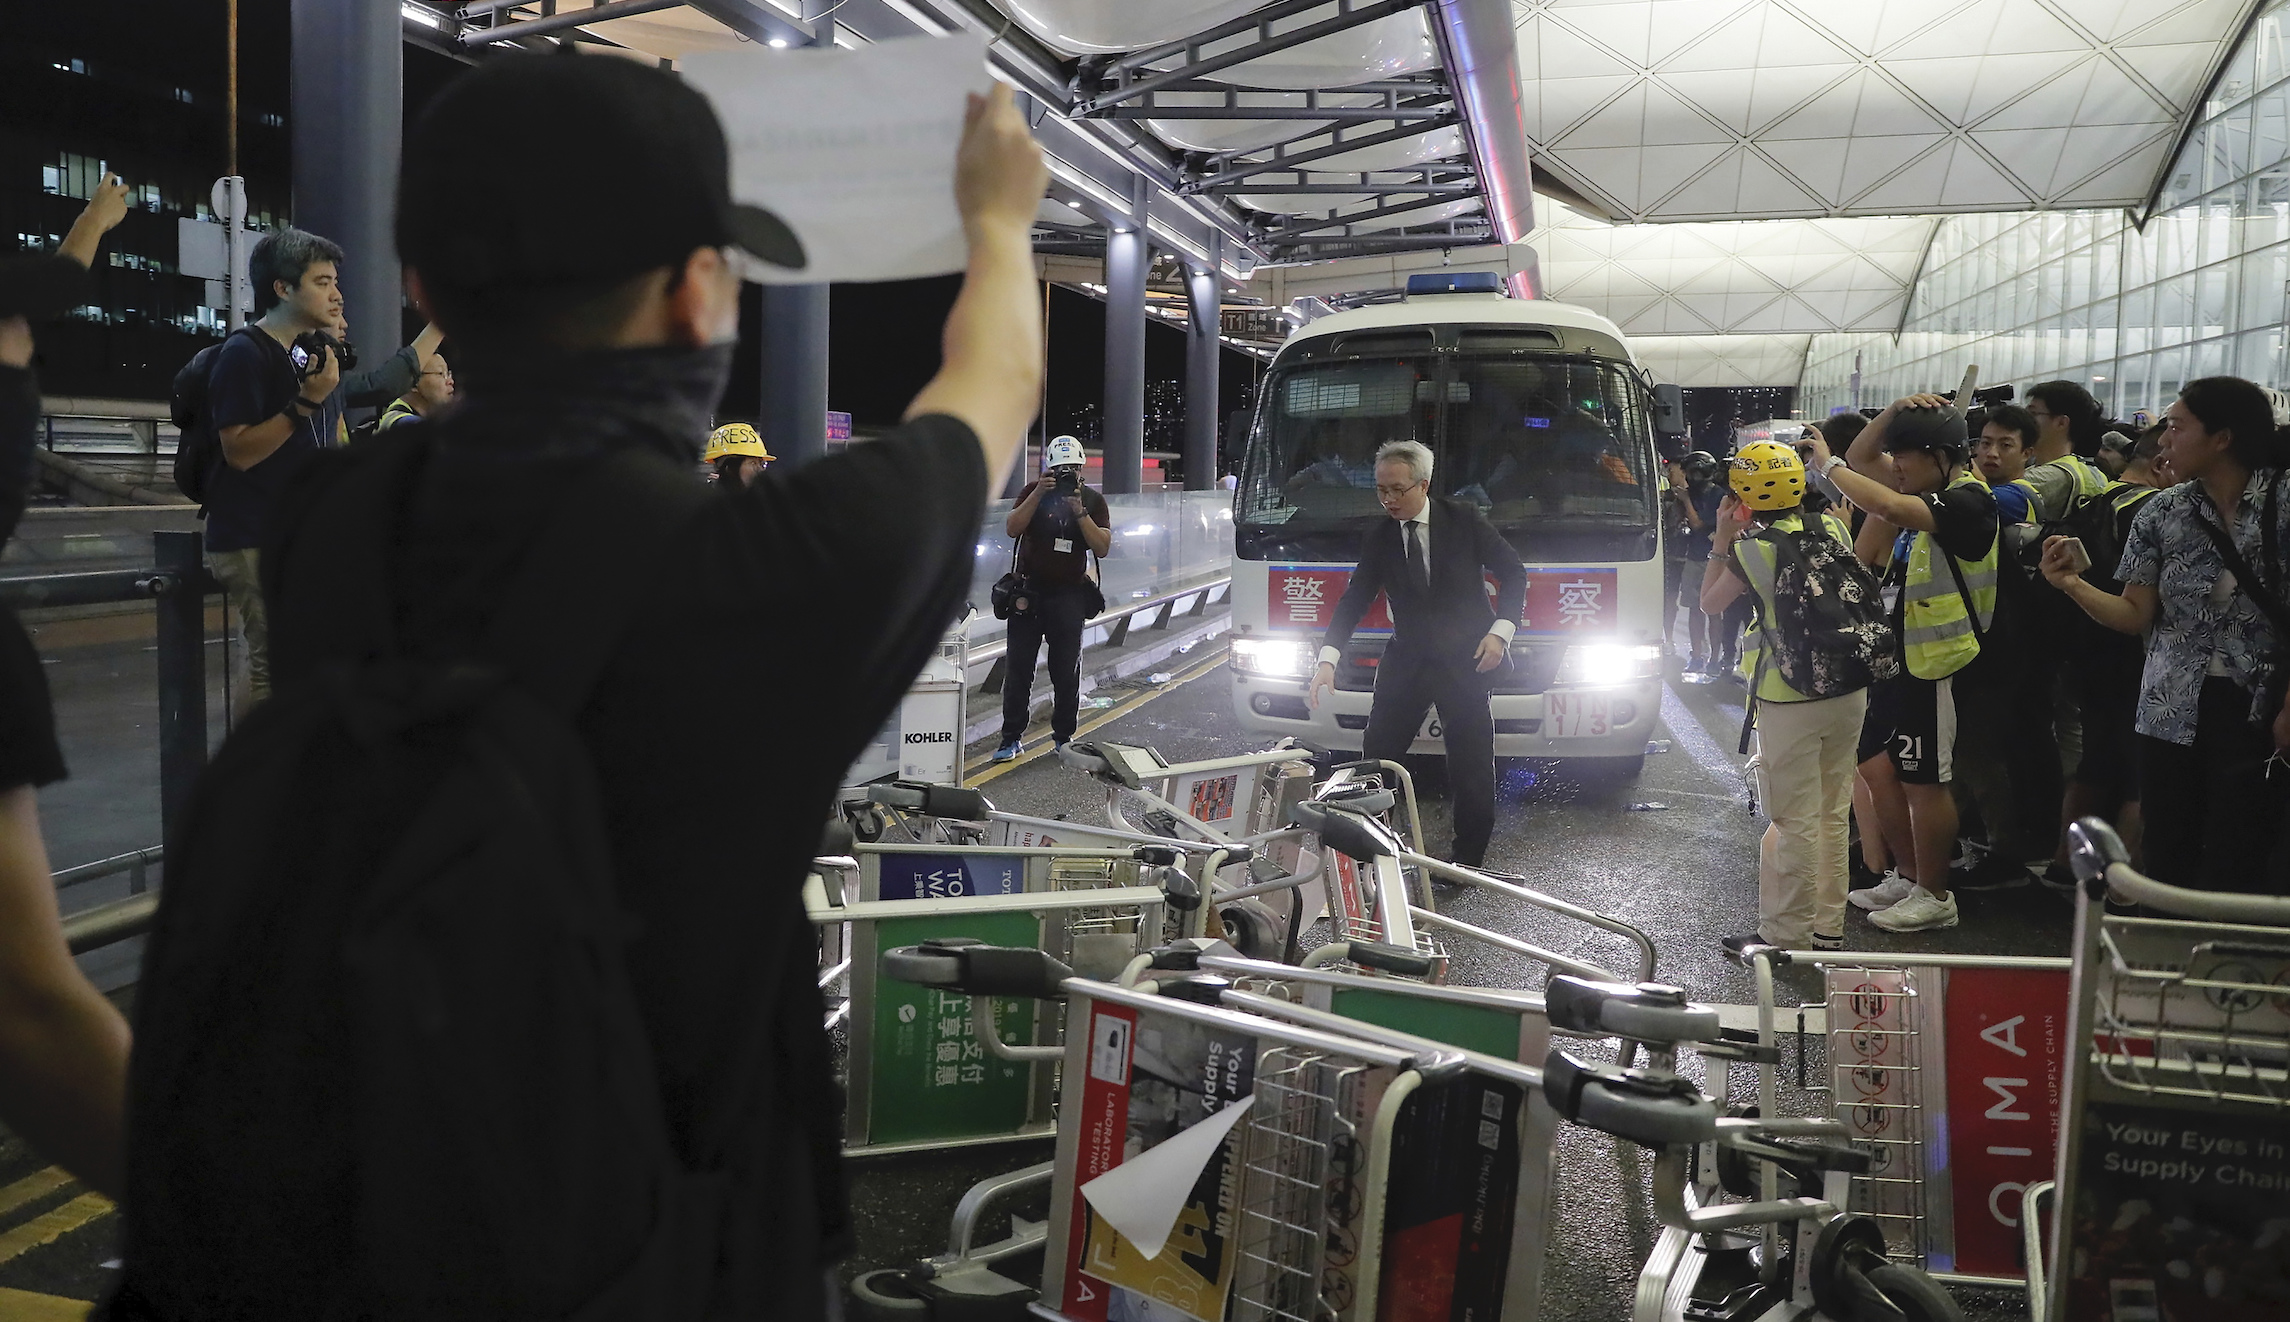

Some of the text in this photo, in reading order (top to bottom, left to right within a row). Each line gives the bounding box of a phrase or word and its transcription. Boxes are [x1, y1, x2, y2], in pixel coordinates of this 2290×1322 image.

[1227, 314, 1243, 330] T1
[1248, 322, 1267, 332] Zone
[711, 427, 757, 448] PRESS
[1767, 457, 1792, 470] 記者
[1282, 576, 1325, 623] 警
[1557, 579, 1603, 626] 察
[1551, 693, 1608, 715] NTN
[905, 732, 953, 744] KOHLER
[1898, 734, 1922, 759] 21
[935, 991, 963, 1087] 上享優惠
[2044, 1015, 2055, 1054] CHAIN
[1201, 1040, 1223, 1113] Supply
[1228, 1047, 1243, 1095] Your
[2047, 1059, 2058, 1104] SUPPLY
[1980, 1014, 2034, 1228] QIMA
[2050, 1110, 2060, 1134] THE
[1088, 1121, 1103, 1175] TESTING
[2105, 1122, 2171, 1148] Your
[2181, 1131, 2248, 1155] Eyes
[2104, 1151, 2206, 1184] Supply
[1214, 1211, 1233, 1238] ON
